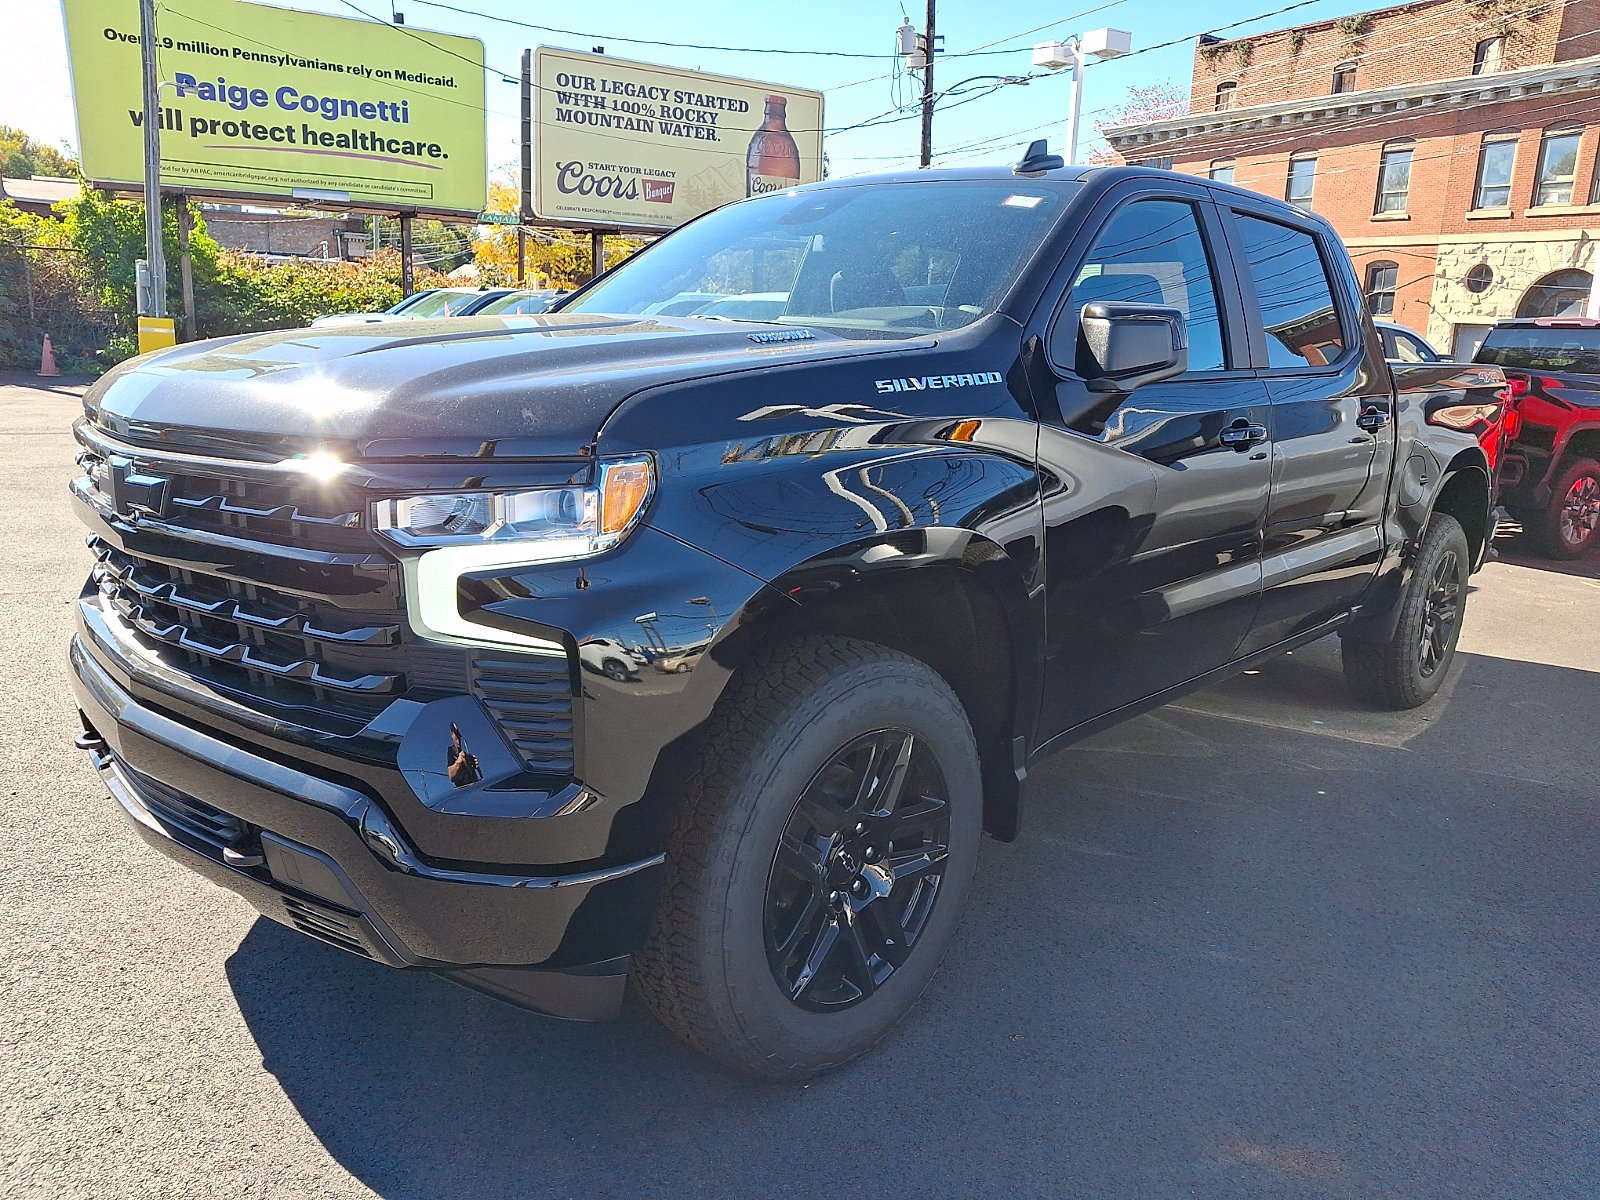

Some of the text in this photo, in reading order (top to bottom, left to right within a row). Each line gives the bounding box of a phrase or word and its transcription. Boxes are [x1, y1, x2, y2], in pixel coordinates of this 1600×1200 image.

[177, 40, 229, 57] million
[233, 47, 343, 72] Pennsylvanians
[347, 64, 372, 78] rely
[375, 69, 391, 79] on
[395, 70, 457, 88] Medicaid.
[175, 72, 409, 123] Paige Cognetti
[556, 72, 749, 113] OUR LEGACY STARTED
[556, 91, 719, 125] WITH 100% ROCKY
[190, 117, 296, 144] protect
[302, 123, 449, 159] healthcare.
[555, 107, 722, 142] MOUNTAIN WATER.
[556, 161, 639, 200] Coors
[588, 162, 677, 178] START YOUR LEGACY
[645, 182, 673, 200] Banquet
[481, 215, 515, 223] LAMAR
[874, 371, 1003, 394] SILVERADO
